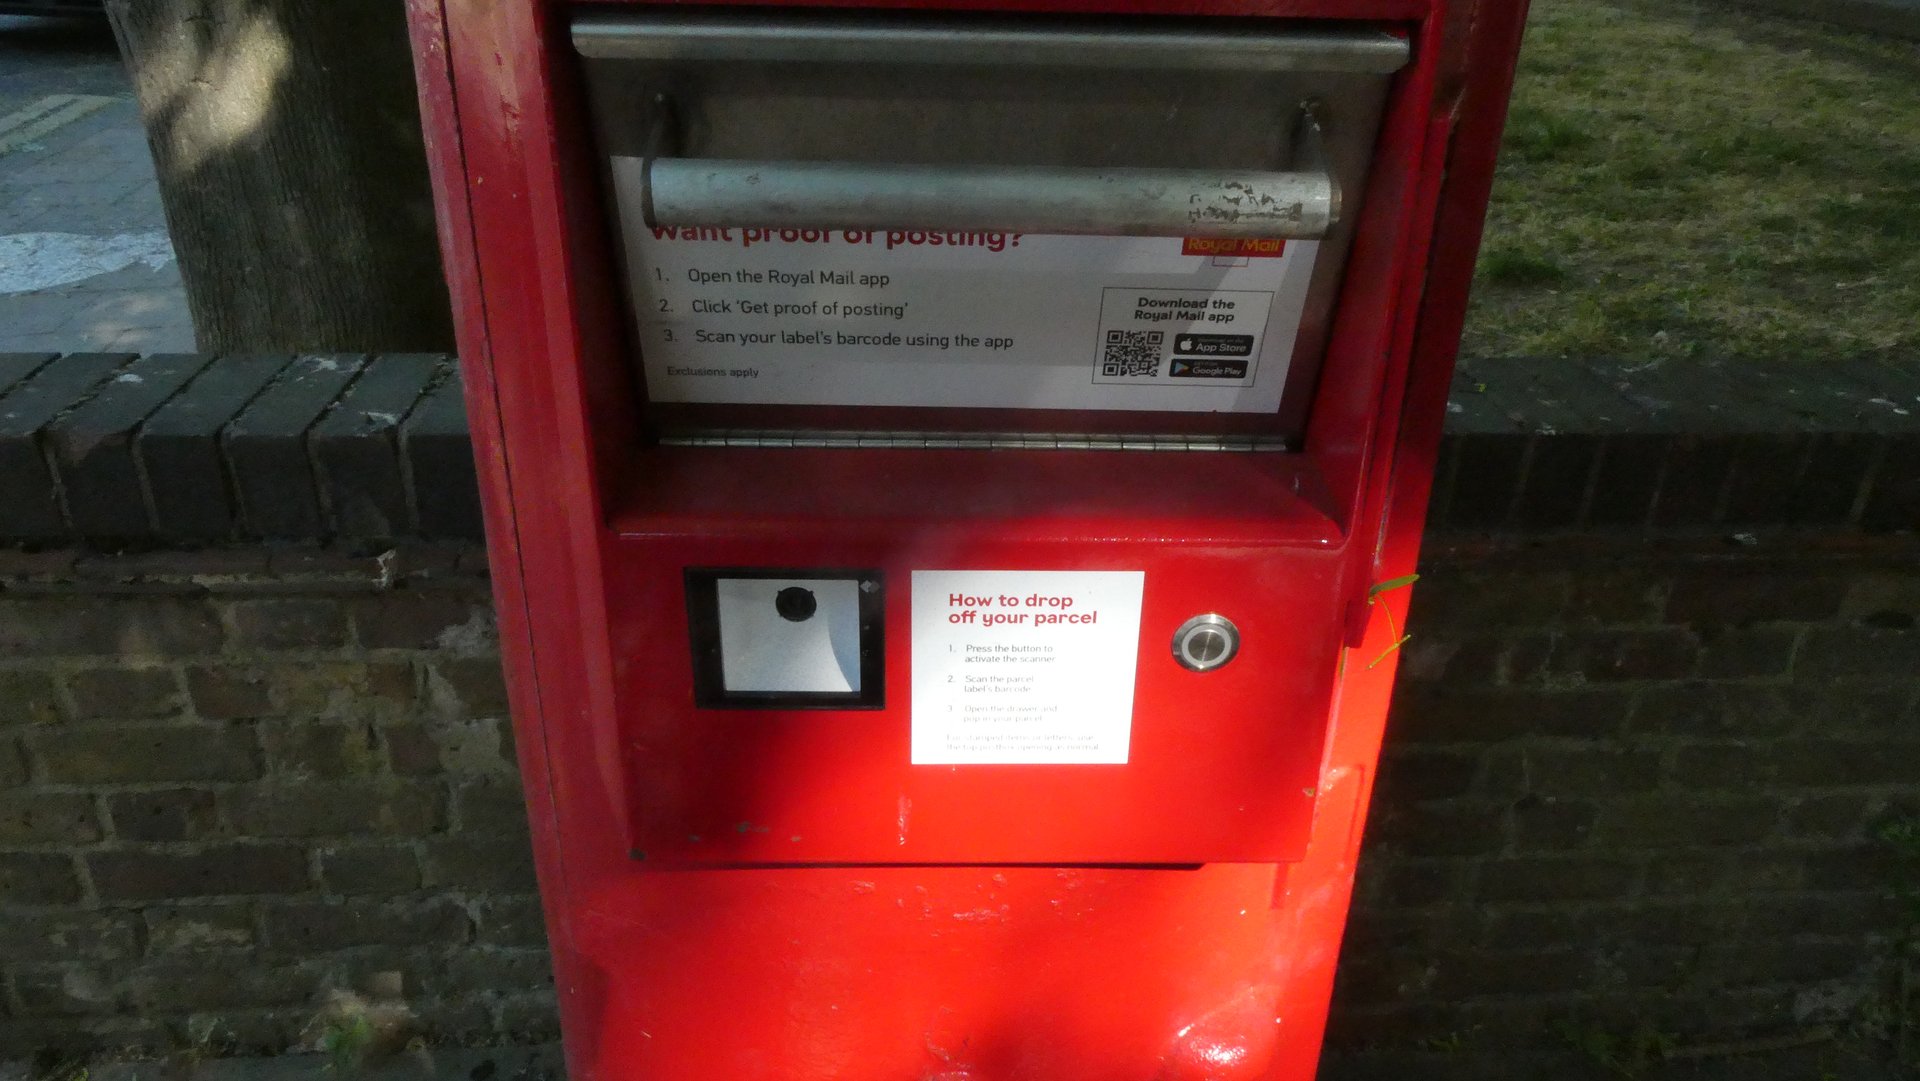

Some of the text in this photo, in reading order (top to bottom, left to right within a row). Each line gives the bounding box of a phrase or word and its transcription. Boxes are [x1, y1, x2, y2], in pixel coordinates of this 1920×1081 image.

[742, 227, 830, 247] proof
[843, 230, 874, 244] of
[655, 268, 890, 289] 1. Open the Royal Mail app
[659, 299, 909, 321] 2. Click 'Get proof of posting'
[1137, 297, 1236, 310] Download the
[1134, 310, 1235, 324] Royal Mail app
[663, 329, 1014, 351] 3. Scan your label's barcode using the app
[1195, 343, 1247, 353] App Store
[667, 366, 759, 379] Exclusions apply
[1193, 366, 1242, 376] Google Play
[949, 593, 1073, 610] How to drop
[948, 610, 1097, 627] off your parcel
[949, 644, 1054, 653] 1. Press the button to
[964, 655, 1057, 664] activate the scanner
[965, 674, 988, 683] Scan
[990, 674, 1005, 683] the
[1006, 675, 1034, 684] parcel
[964, 684, 1031, 693] label's barcode
[964, 704, 988, 713] Open
[990, 704, 1005, 712] the
